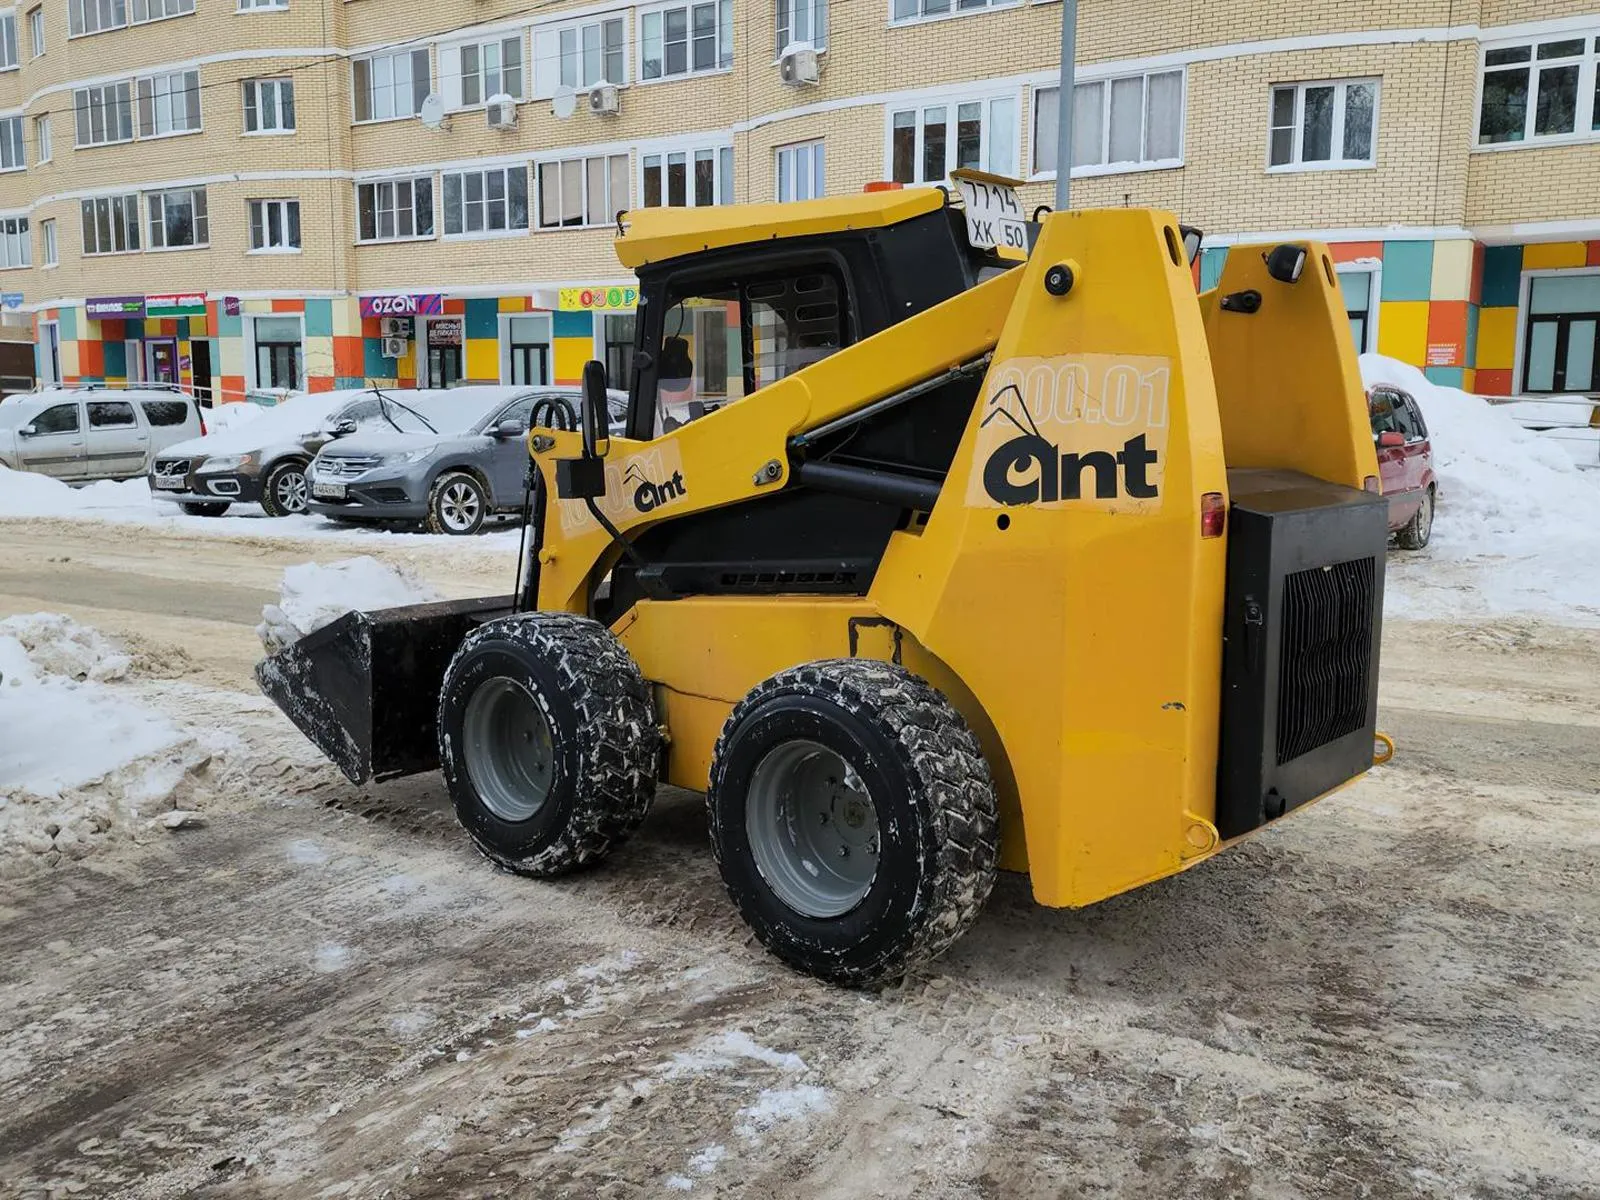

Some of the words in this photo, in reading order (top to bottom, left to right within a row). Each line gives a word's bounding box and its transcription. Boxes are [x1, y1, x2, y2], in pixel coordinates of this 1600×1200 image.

[963, 180, 1018, 214] 7714
[1005, 225, 1024, 248] 50
[372, 295, 417, 313] OZON
[982, 432, 1159, 507] ant
[634, 469, 687, 513] ant
